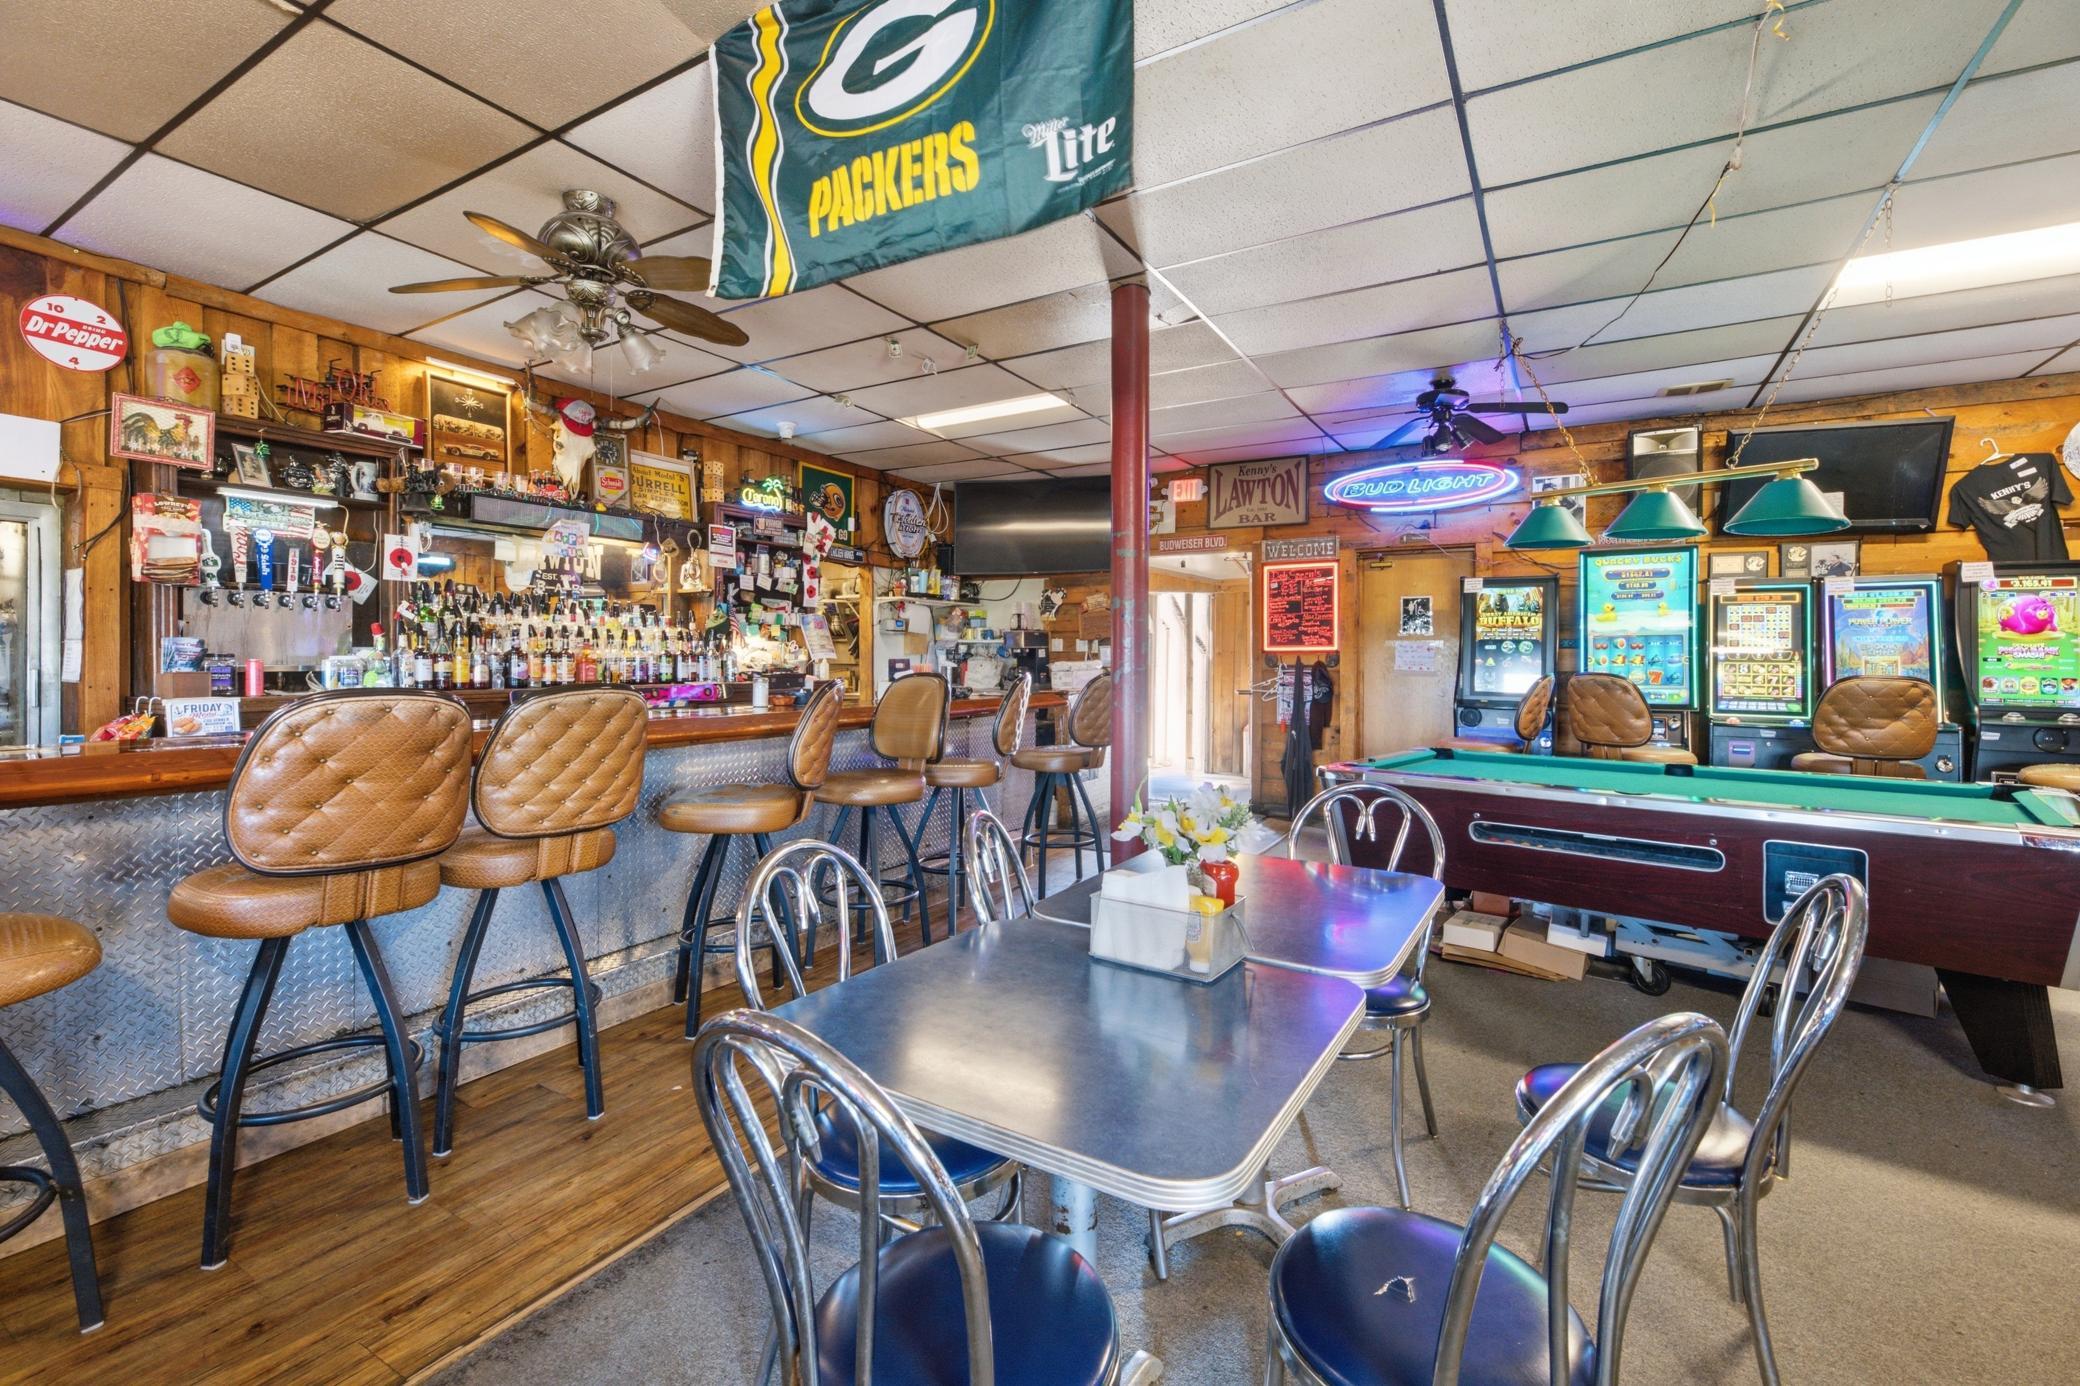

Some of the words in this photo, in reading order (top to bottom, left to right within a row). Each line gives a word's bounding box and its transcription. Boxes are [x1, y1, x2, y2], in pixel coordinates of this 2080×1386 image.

[1021, 116, 1070, 149] Miller
[1043, 116, 1117, 182] Lite
[808, 120, 982, 238] PACKERS
[46, 302, 65, 314] 10
[96, 315, 107, 325] 2
[25, 315, 55, 334] Dr
[51, 322, 124, 351] Pepper
[68, 356, 80, 366] 4
[1238, 464, 1278, 477] Kenny's
[1175, 480, 1197, 499] EXIT
[1215, 462, 1302, 521] LAWTON
[1343, 480, 1405, 498] BUD
[1407, 474, 1495, 494] LIGHT
[742, 487, 780, 509] Corona
[1239, 512, 1277, 524] BAR
[1159, 538, 1203, 551] BUDWEISER
[1205, 535, 1227, 548] BLVD.
[1267, 542, 1334, 558] WELCOME
[1479, 615, 1540, 625] BUFFALO
[183, 703, 222, 714] FRIDAY
